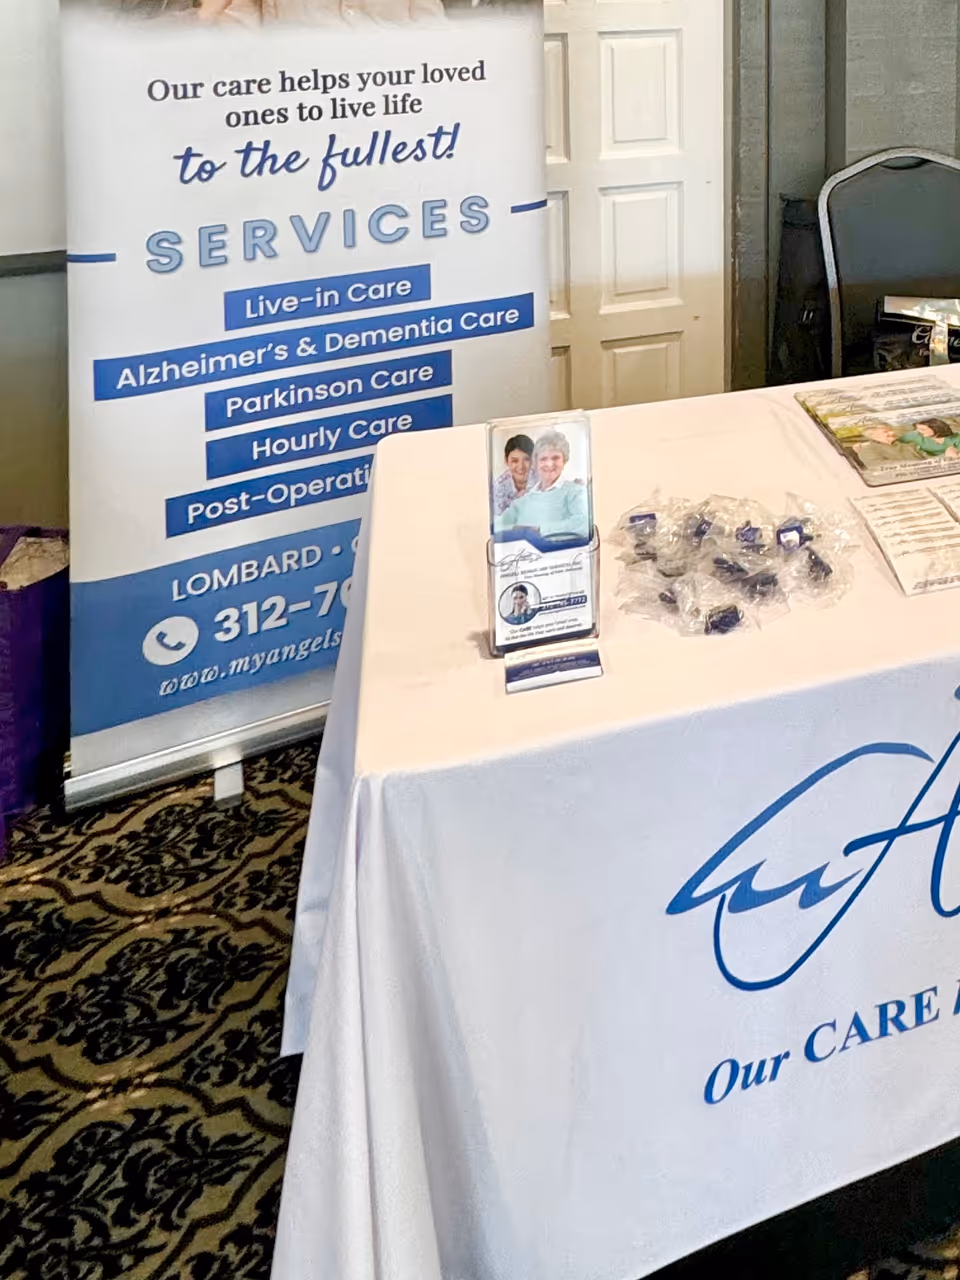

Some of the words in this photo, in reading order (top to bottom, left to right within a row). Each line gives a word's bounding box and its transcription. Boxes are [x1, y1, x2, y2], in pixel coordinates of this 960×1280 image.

[147, 80, 202, 102] Our
[212, 78, 272, 97] care
[279, 69, 351, 95] helps
[356, 66, 416, 91] your
[421, 60, 487, 85] loved
[225, 106, 289, 128] ones
[297, 101, 323, 122] to
[329, 95, 376, 120] live
[382, 92, 424, 116] life
[172, 145, 227, 185] to
[234, 139, 310, 179] the
[316, 122, 462, 192] fullest!
[145, 195, 491, 274] SERVICES
[244, 287, 340, 321] Live-in
[347, 277, 413, 304] Care
[115, 340, 291, 391] Alzheimer's
[295, 336, 320, 358] &
[324, 315, 455, 356] Dementia
[460, 305, 522, 333] Care
[225, 375, 364, 419] Parkinson
[370, 363, 435, 389] Care
[251, 424, 343, 461] Hourly
[348, 411, 414, 438] Care
[171, 546, 322, 602] LOMBARD
[703, 1048, 790, 1105] Our
[803, 986, 941, 1063] CARE
